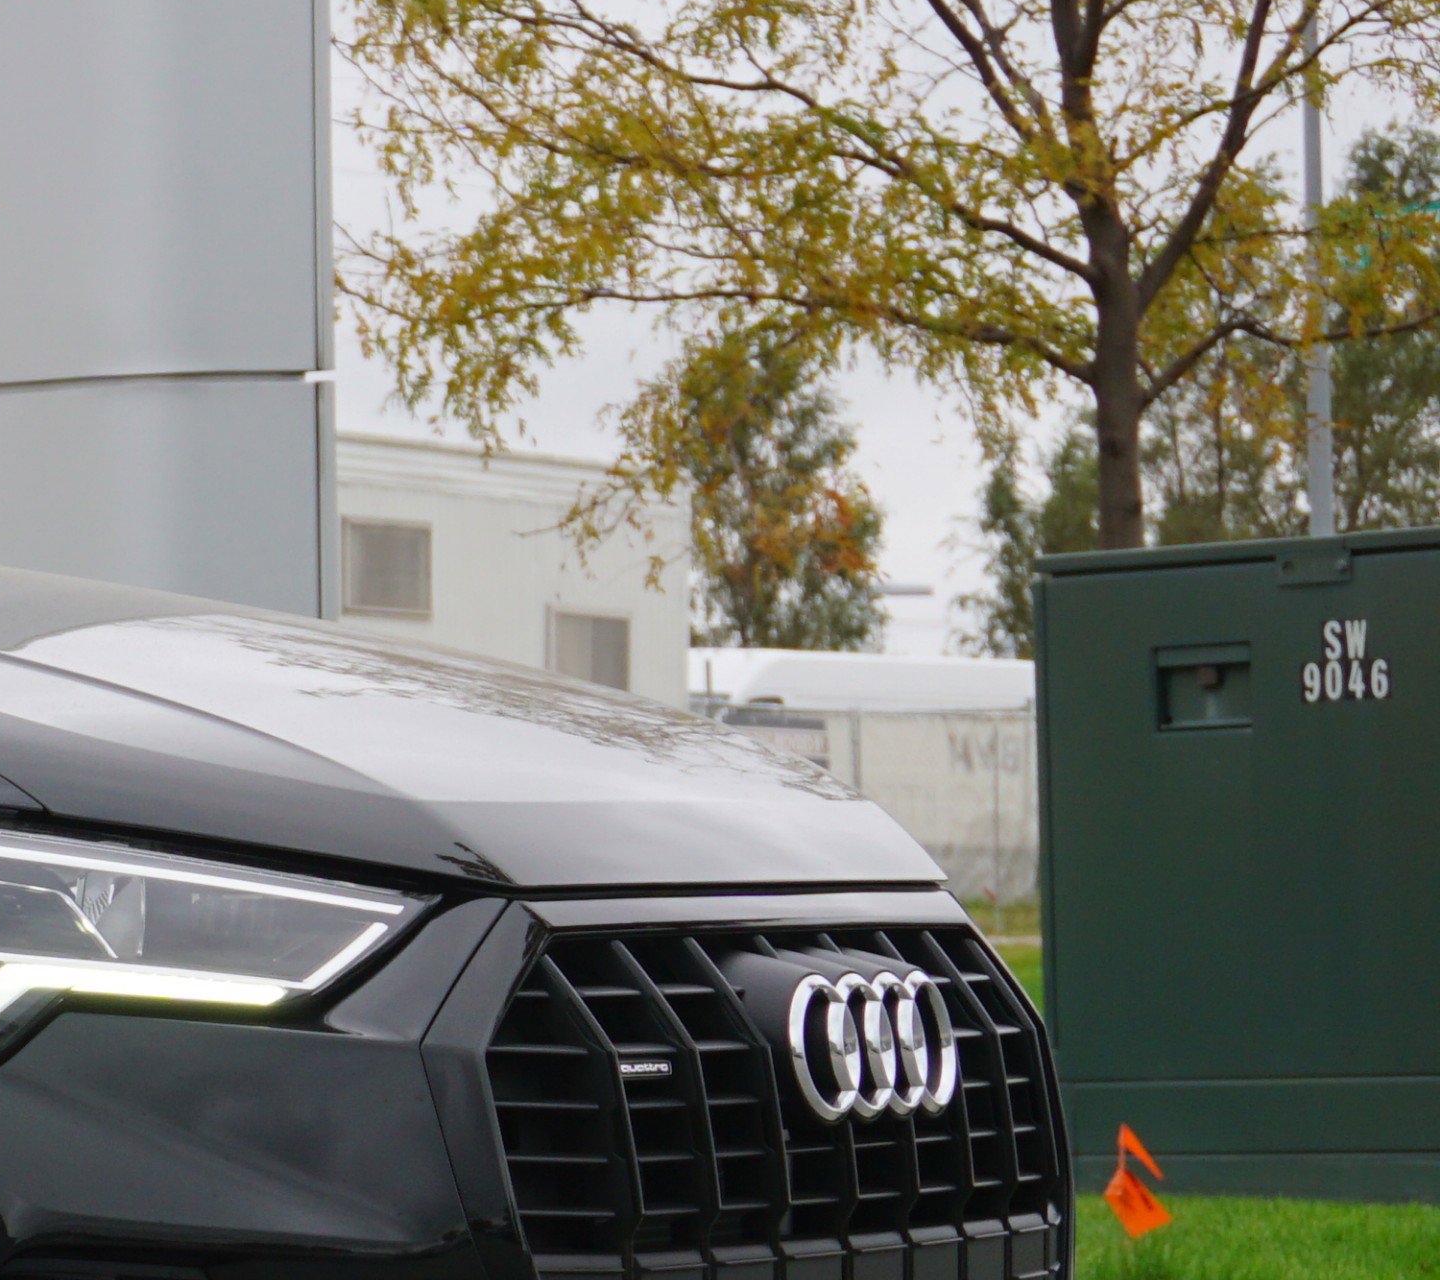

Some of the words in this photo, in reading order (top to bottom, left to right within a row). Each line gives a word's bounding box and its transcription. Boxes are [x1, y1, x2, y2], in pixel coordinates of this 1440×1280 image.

[1323, 618, 1368, 660] SW
[1303, 658, 1390, 702] 9046
[620, 1062, 669, 1074] quattro
